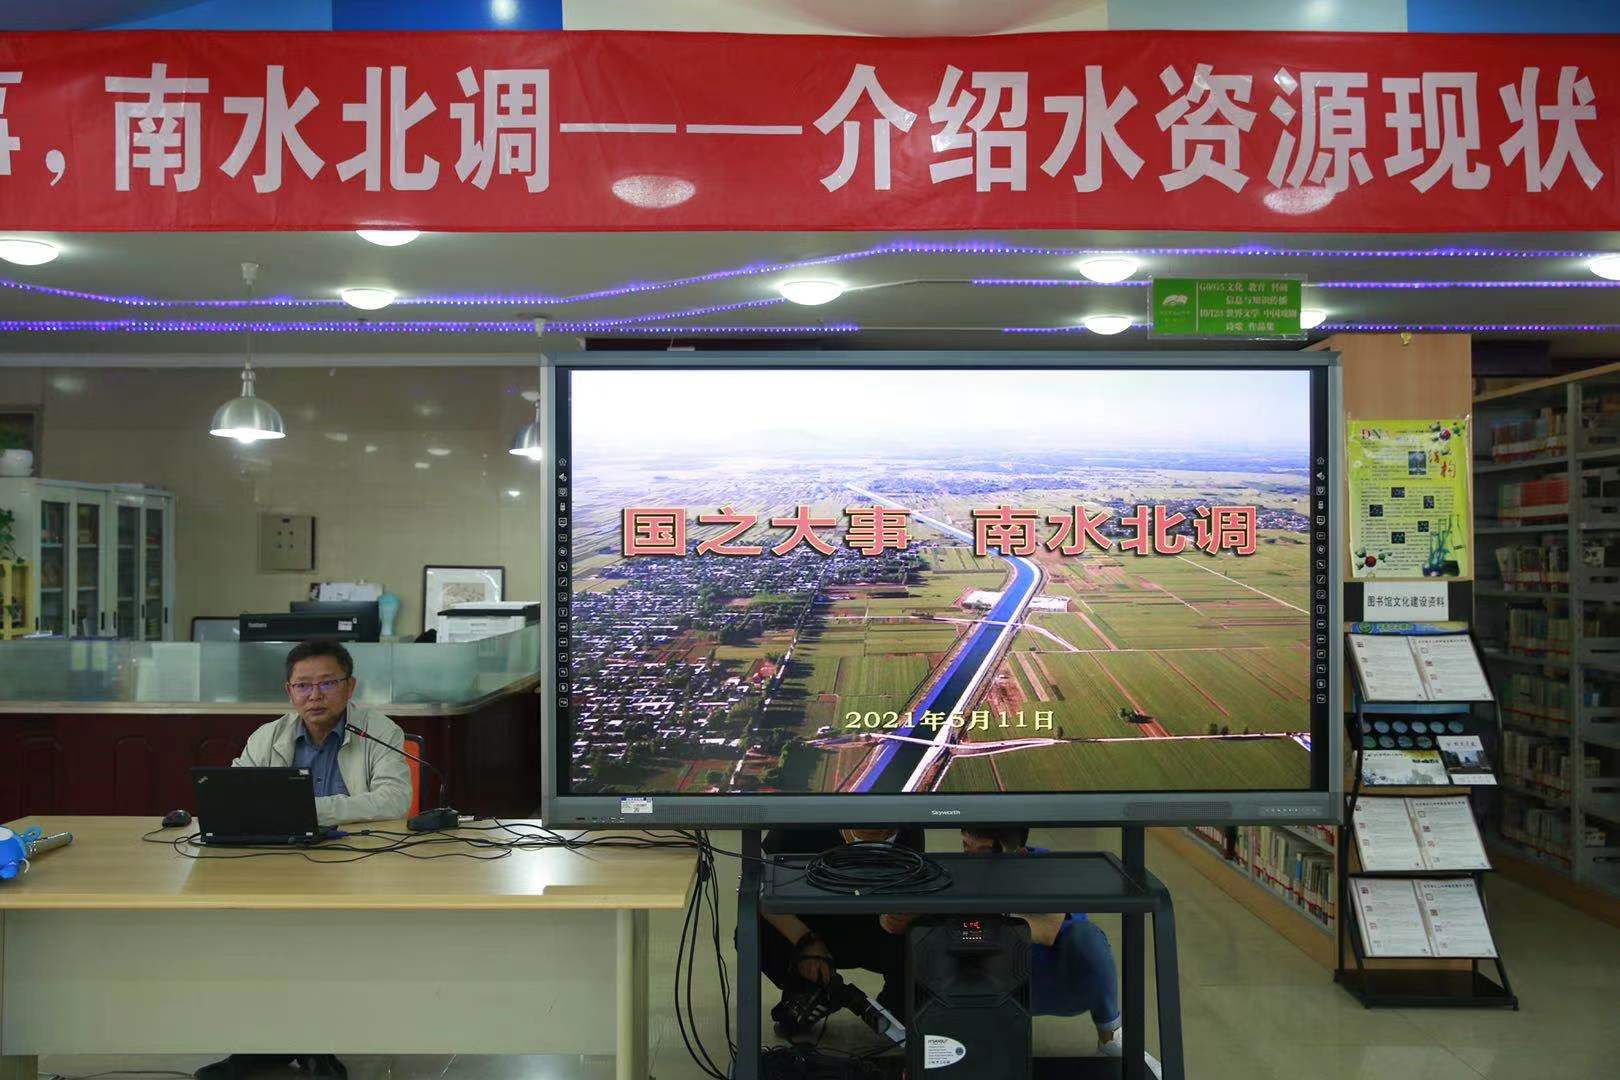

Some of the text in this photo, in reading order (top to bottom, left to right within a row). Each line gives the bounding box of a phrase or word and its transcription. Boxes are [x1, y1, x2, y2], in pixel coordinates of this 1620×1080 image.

[0, 63, 1604, 193] ，南水北调——介绍水资源现状
[621, 504, 1258, 557] 国之大事 南水北调
[1367, 595, 1446, 608] 图书馆文化建设资料
[845, 709, 1056, 732] 2021年5月11日
